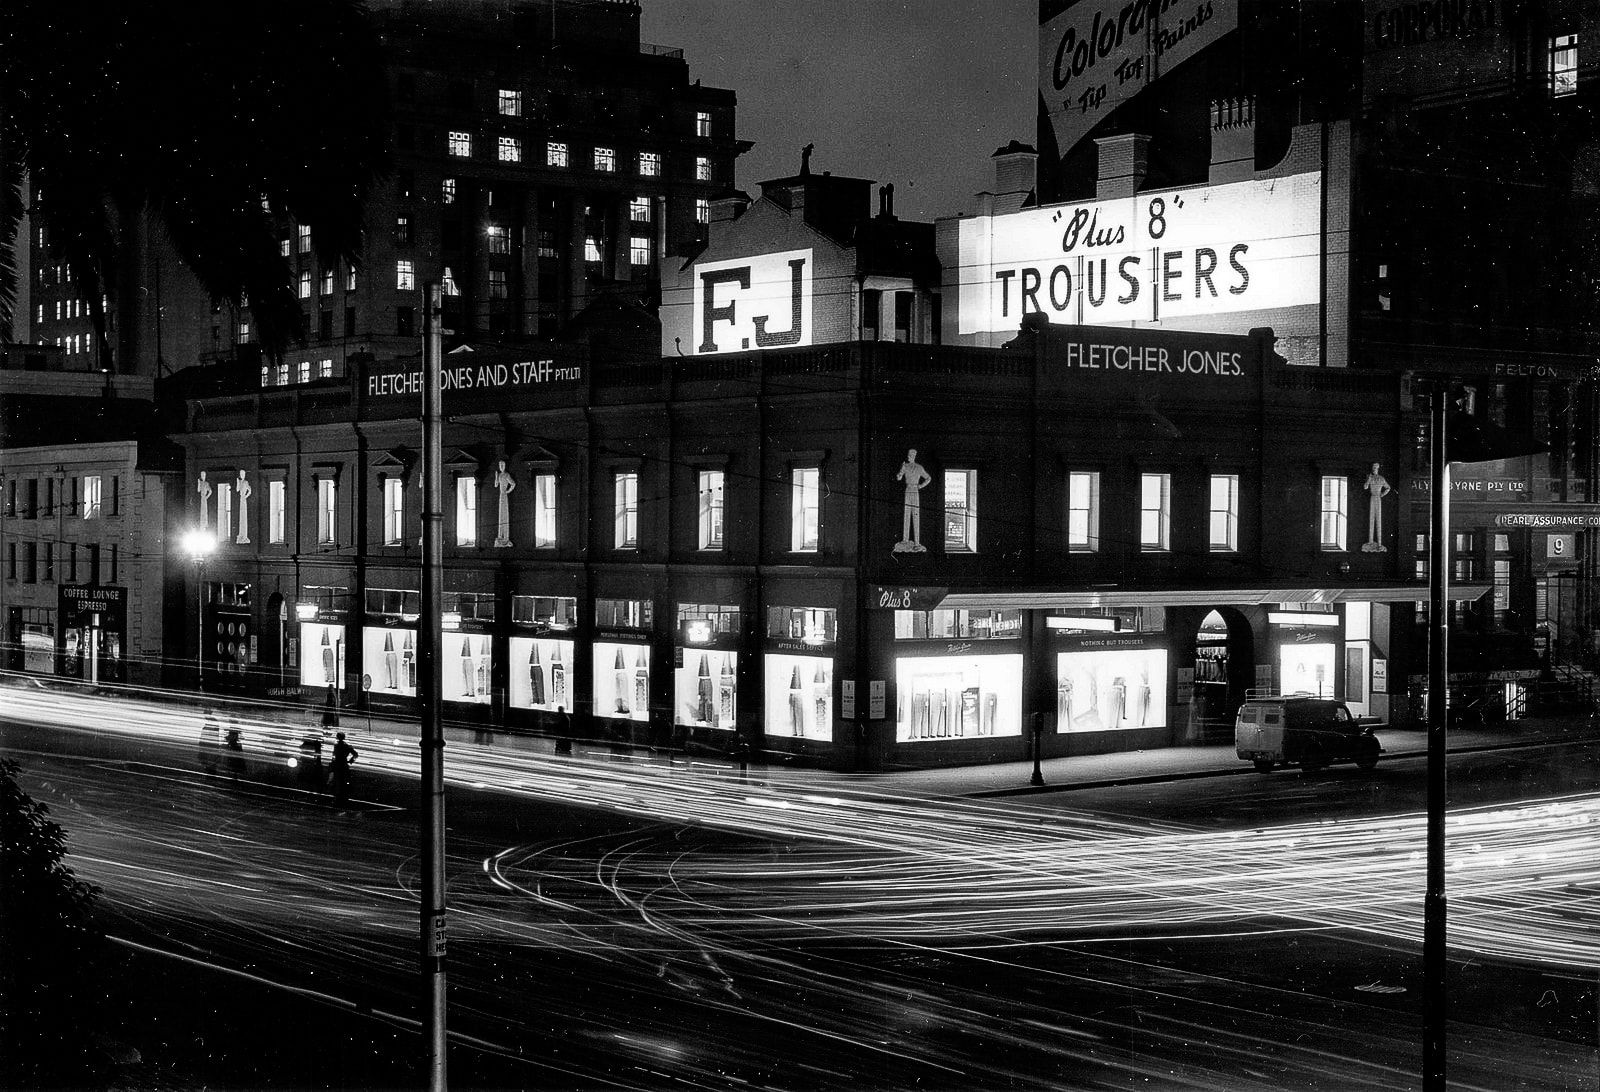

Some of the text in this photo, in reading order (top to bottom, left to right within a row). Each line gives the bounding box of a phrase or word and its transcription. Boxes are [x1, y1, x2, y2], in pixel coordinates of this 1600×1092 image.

[1078, 84, 1106, 113] Tip
[1114, 58, 1144, 85] Top
[1153, 1, 1214, 56] Paints
[995, 243, 1249, 317] TROUSERS
[1067, 342, 1244, 376] FLETCHER JONES.
[440, 367, 473, 390] ONES
[476, 363, 508, 388] AND
[512, 359, 553, 385] STAFF
[1495, 363, 1557, 377] FELTON
[1487, 481, 1504, 492] PTY
[1508, 481, 1524, 492] LTD
[1501, 516, 1600, 526] PEARL ASSURANCE CO
[1554, 538, 1565, 555] 9
[63, 588, 120, 600] COFFEE LOUNGE
[77, 600, 107, 611] ESPRESSO
